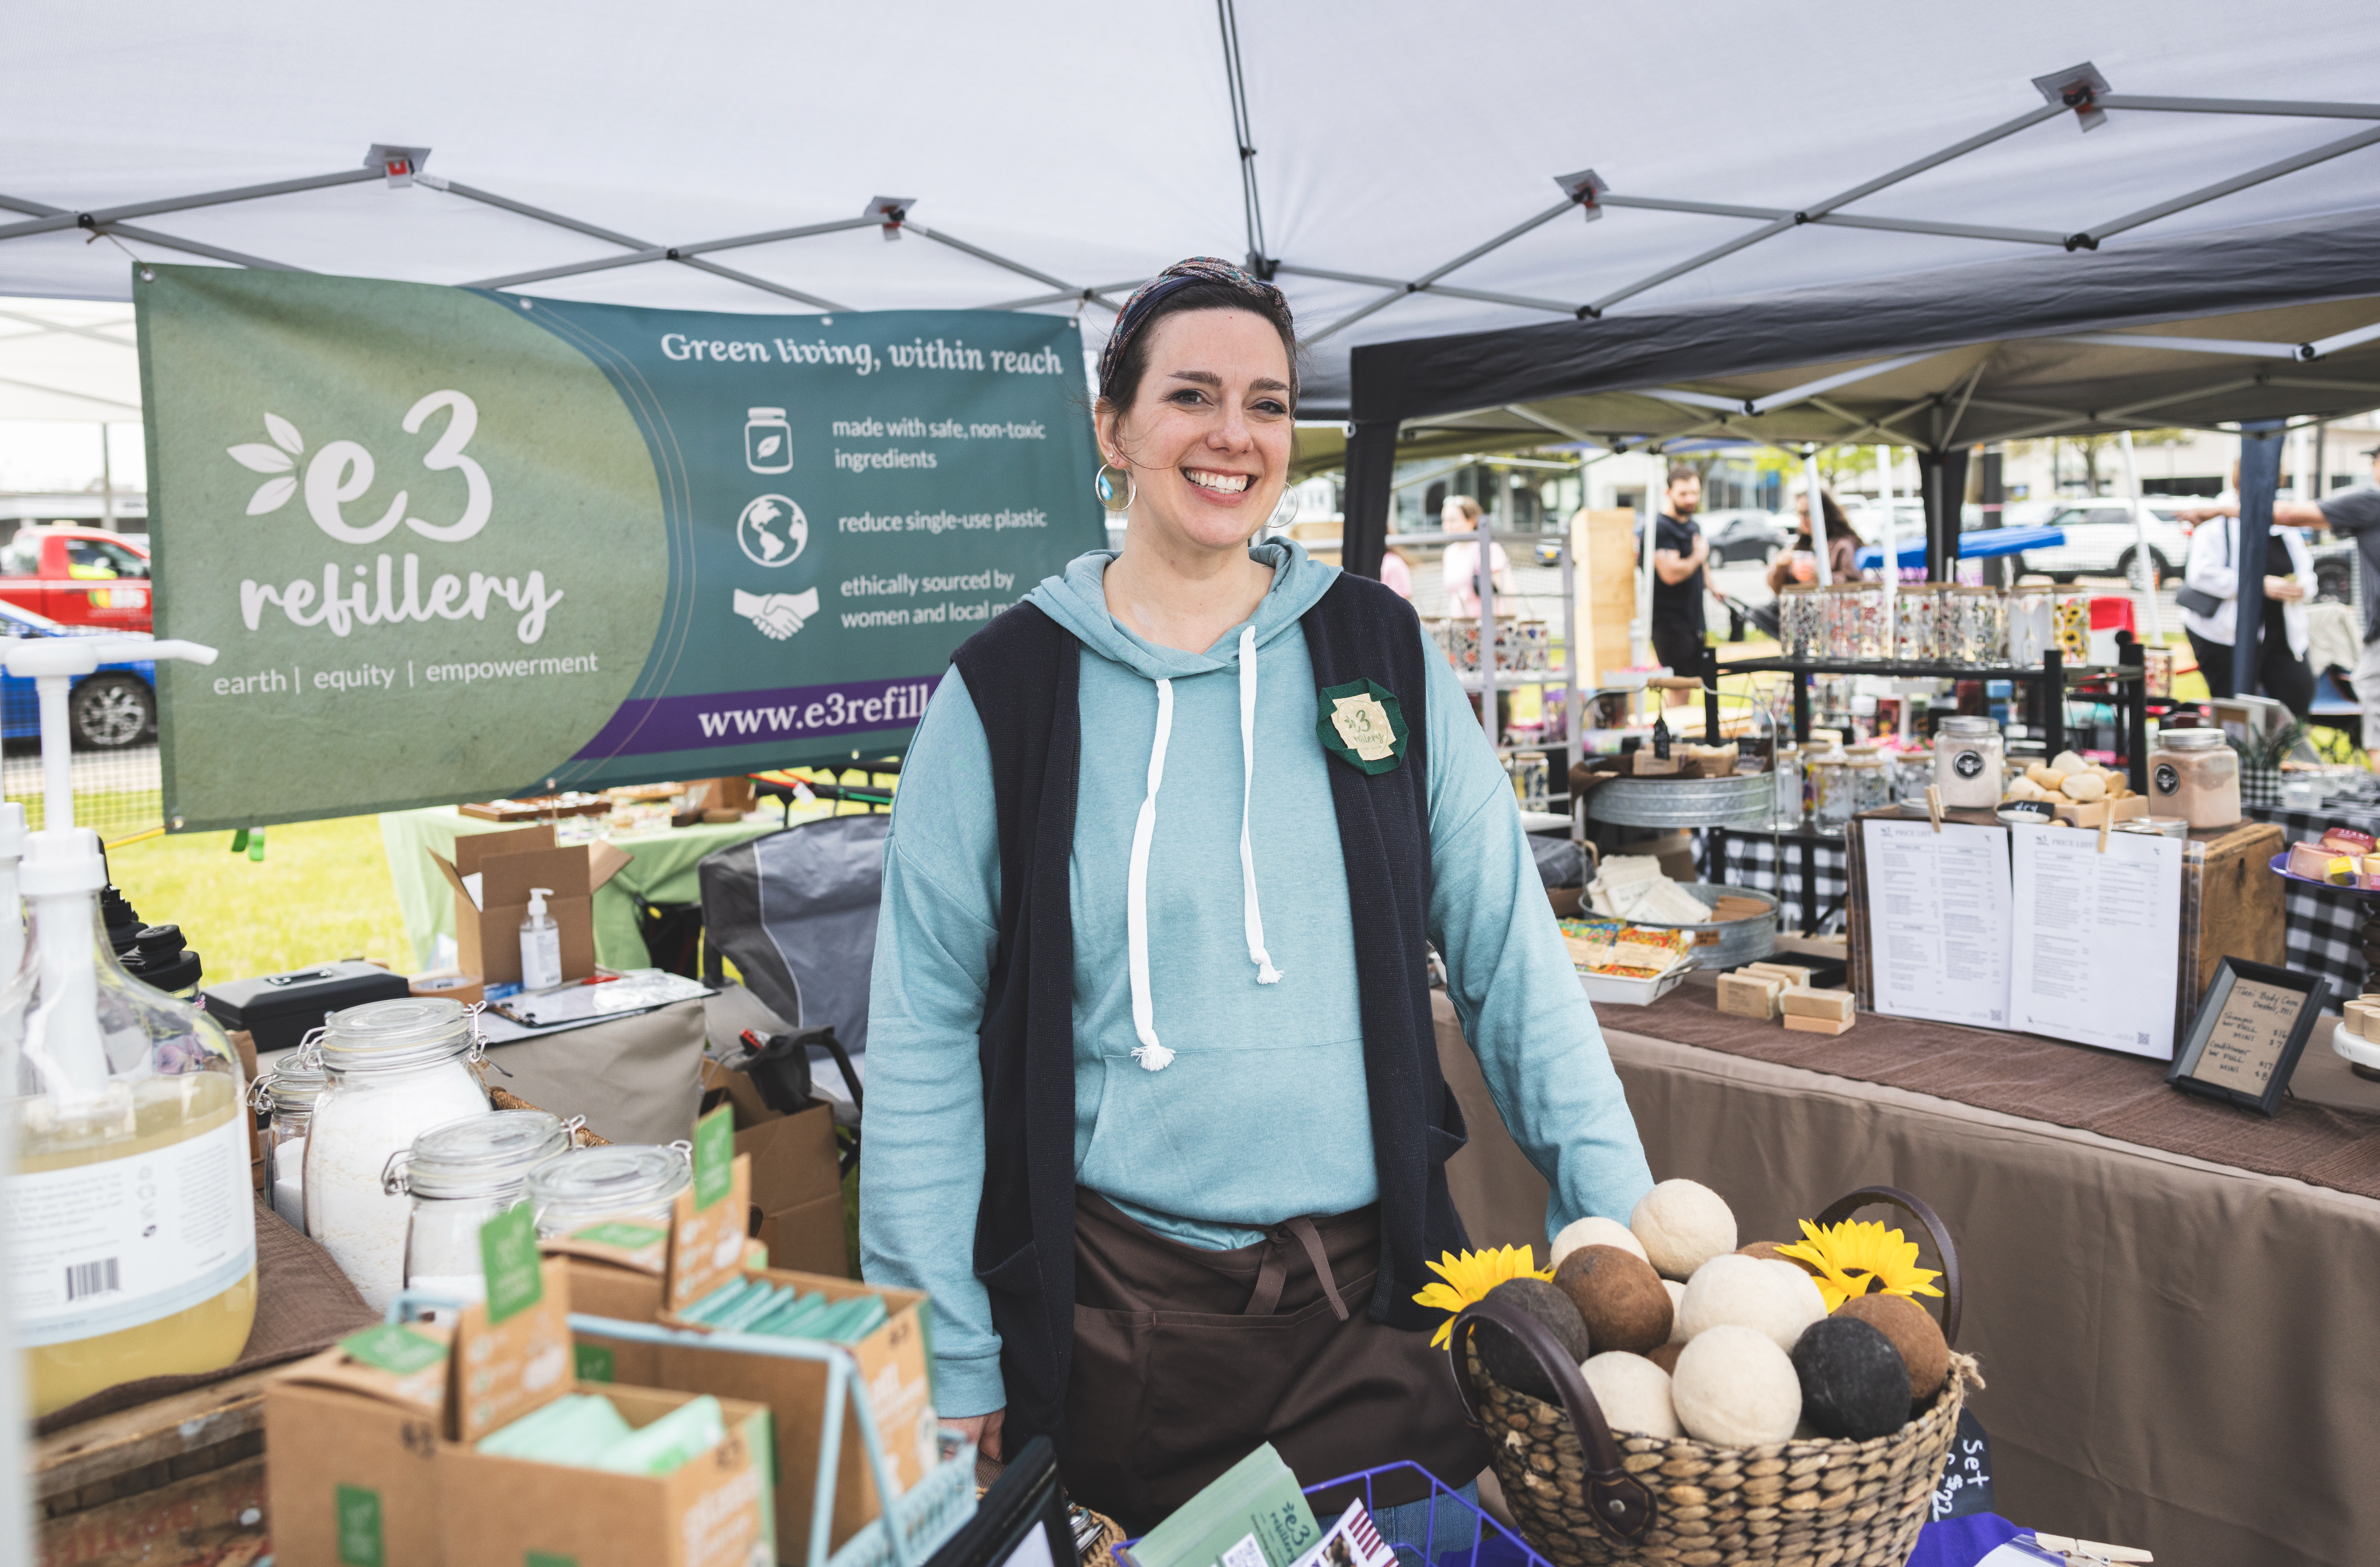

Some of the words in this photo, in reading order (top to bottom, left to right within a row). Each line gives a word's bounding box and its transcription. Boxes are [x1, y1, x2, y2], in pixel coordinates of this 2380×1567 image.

[660, 333, 771, 362] Green
[773, 337, 881, 375] living,
[888, 337, 985, 371] within
[990, 346, 1064, 374] reach
[832, 417, 884, 437] made
[886, 417, 926, 437] with
[928, 418, 968, 440] safe,
[969, 420, 1047, 439] non-toxic
[304, 389, 493, 545] e3
[834, 448, 938, 473] ingredients
[838, 512, 904, 533] reduce
[905, 510, 993, 535] single-use
[994, 508, 1048, 531] plastic
[240, 553, 564, 644] refillery
[840, 573, 920, 597] ethically
[921, 569, 992, 593] sourced
[993, 569, 1015, 591] by
[841, 609, 910, 628] women
[912, 602, 946, 624] and
[949, 599, 990, 622] local
[213, 667, 287, 696] earth
[313, 662, 396, 692] equity
[425, 652, 599, 685] empowerment
[697, 684, 932, 738] www.e3refill
[2260, 991, 2279, 1003] Body
[2281, 996, 2299, 1007] Care
[1963, 1439, 1990, 1489] Set
[1285, 1513, 1310, 1546] e3
